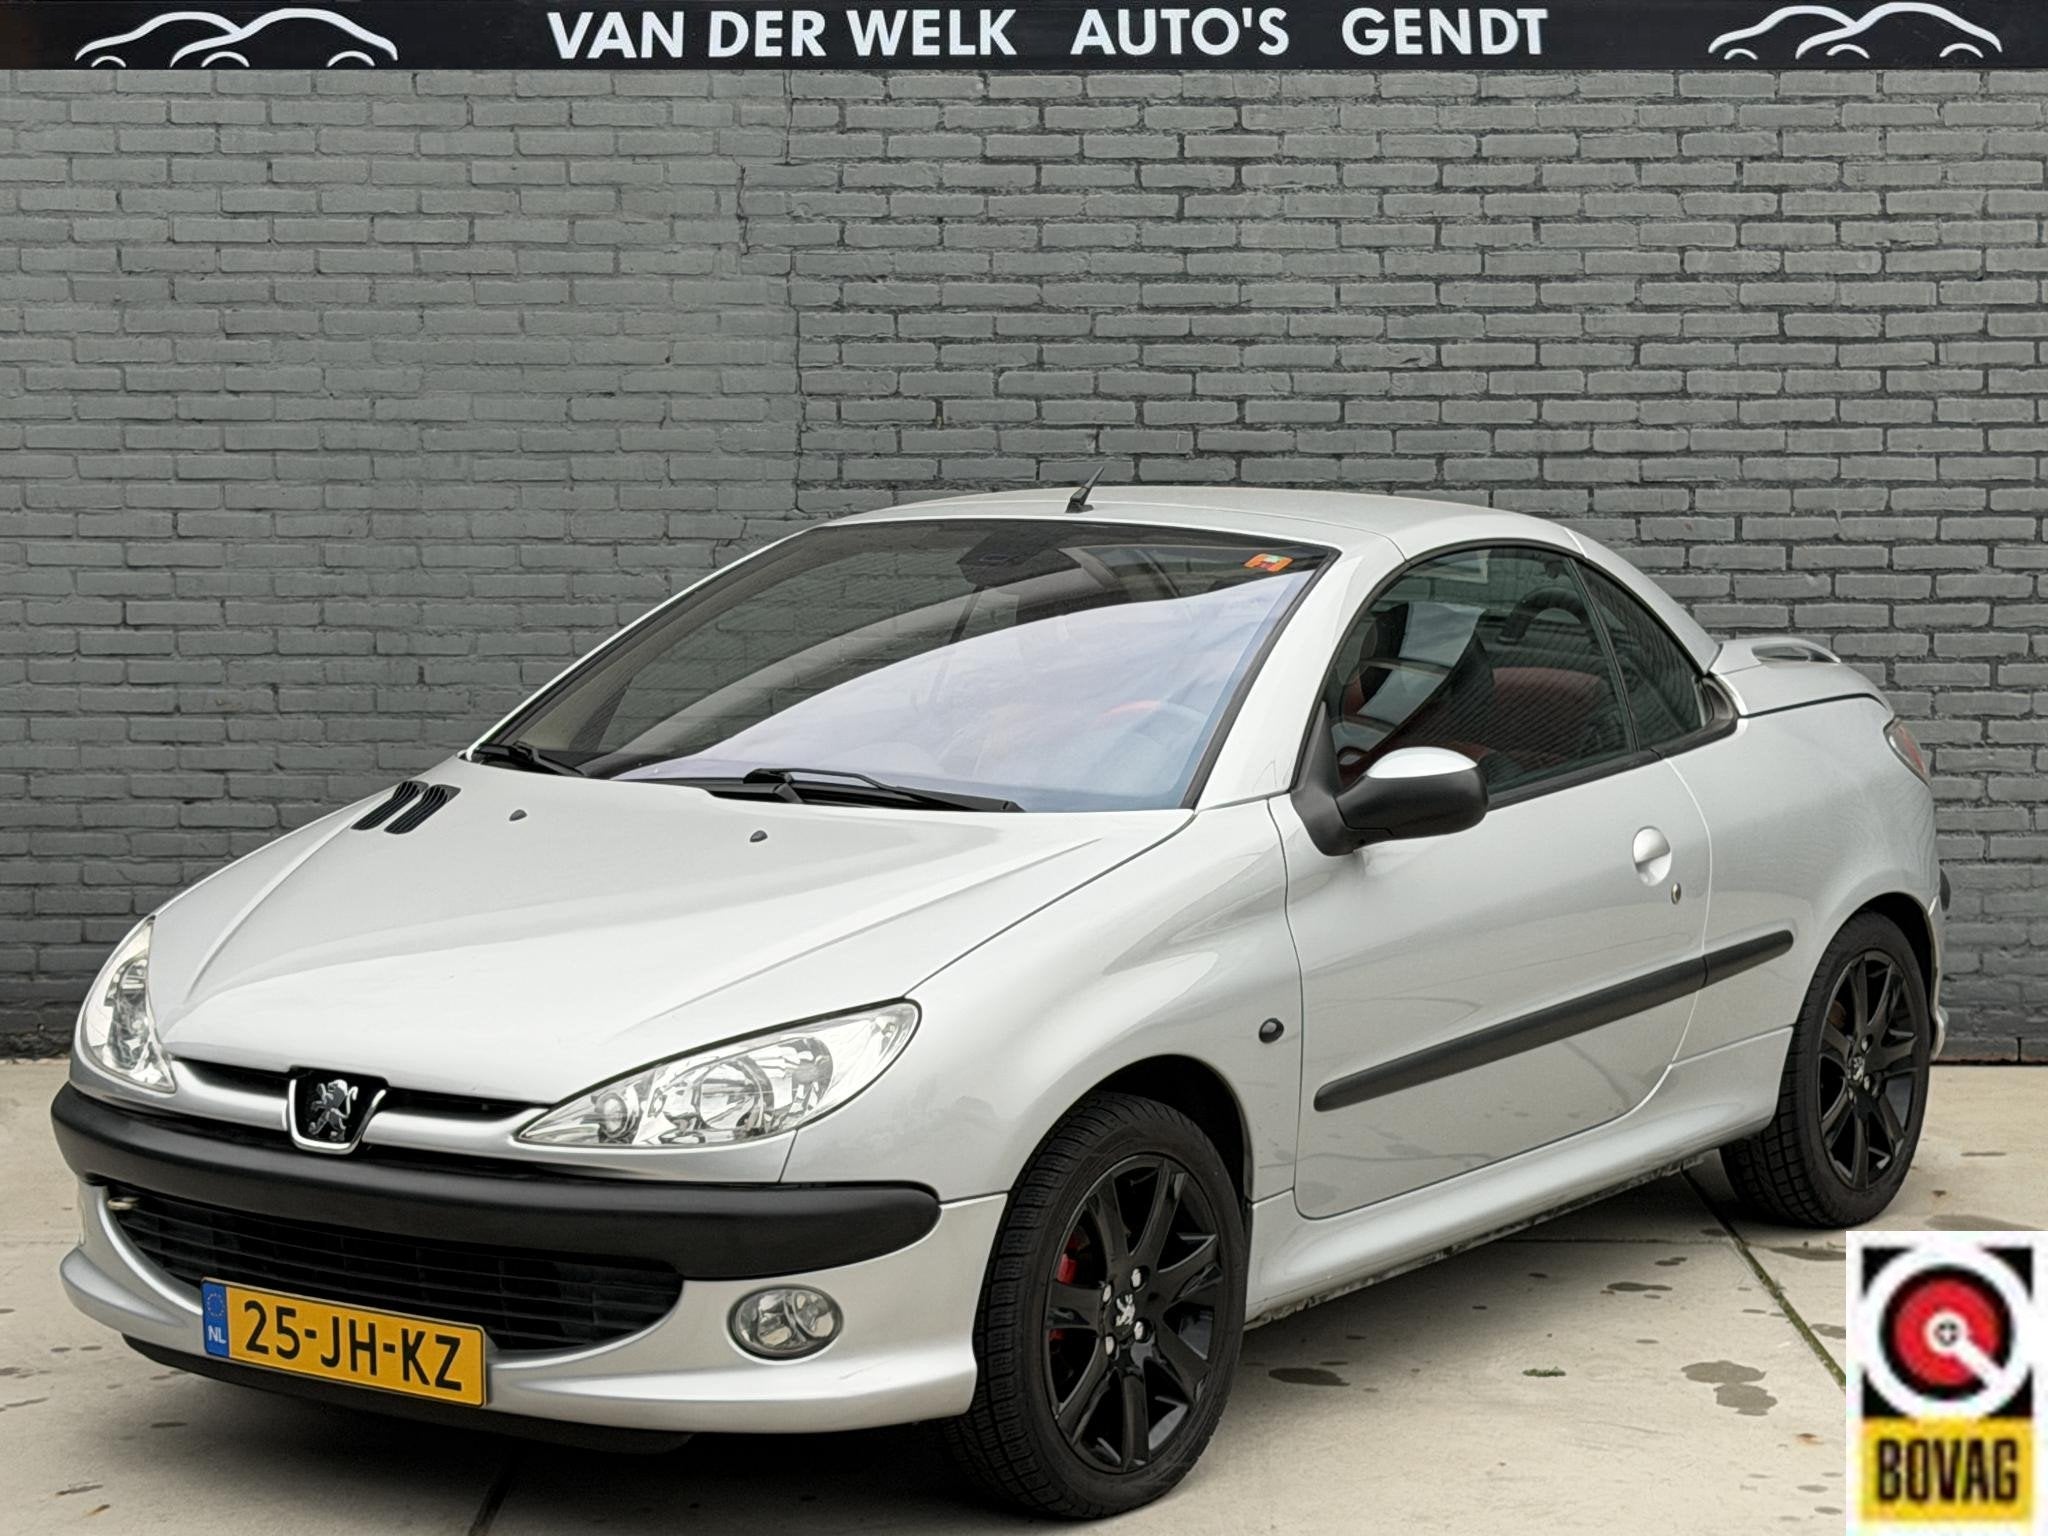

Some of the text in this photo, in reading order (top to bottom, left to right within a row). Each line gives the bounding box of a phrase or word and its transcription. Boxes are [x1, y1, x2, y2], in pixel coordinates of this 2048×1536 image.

[547, 7, 1548, 60] VAN DER WELK AUTO'S GENDT
[207, 1325, 228, 1345] NL
[243, 1300, 463, 1392] 25-JH-KZ
